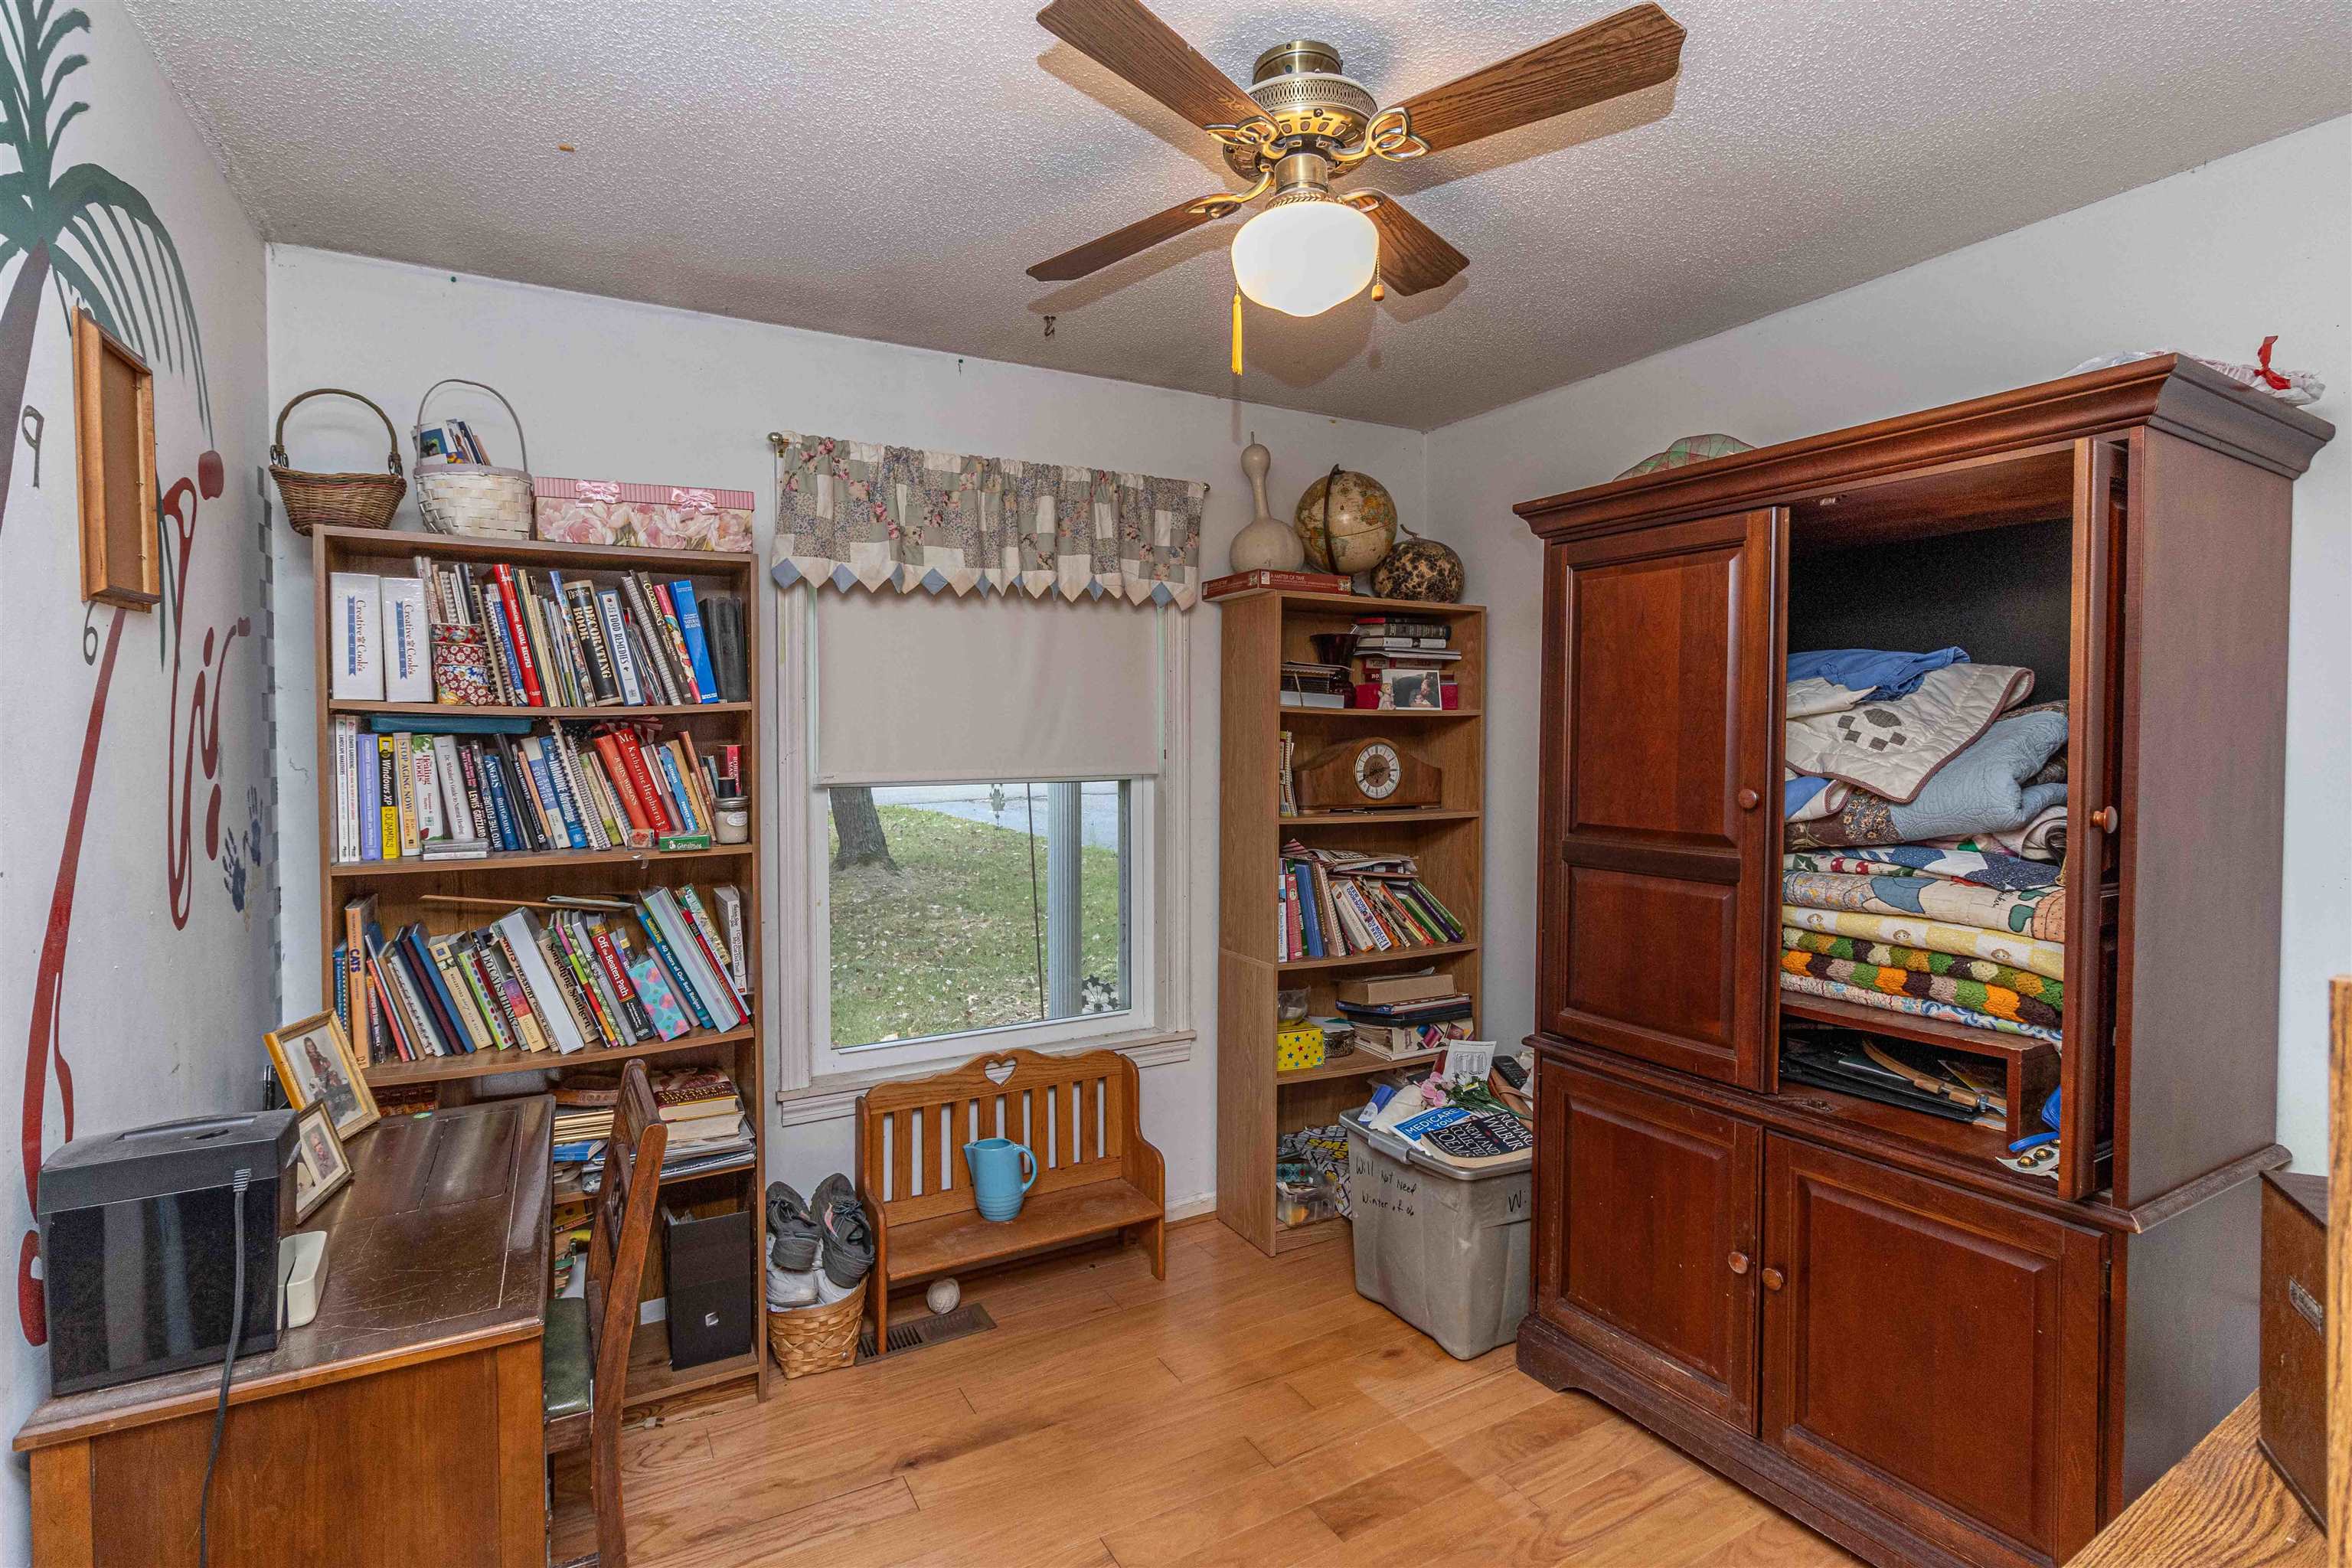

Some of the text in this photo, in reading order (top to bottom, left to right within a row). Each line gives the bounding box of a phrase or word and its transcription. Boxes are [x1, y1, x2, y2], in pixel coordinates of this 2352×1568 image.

[355, 599, 368, 671] Creative Cook's
[403, 605, 418, 675] Creative Cook's
[572, 606, 590, 641] BOOK
[606, 614, 629, 665] FOOD REMEDIES
[516, 624, 532, 668] ANNUAL RECIPES
[583, 605, 612, 679] DECORATING
[506, 651, 521, 688] COOKING
[617, 733, 635, 743] Me
[382, 760, 392, 805] Windows XP
[401, 764, 410, 788] AGING
[416, 758, 424, 782] Foods
[423, 755, 432, 785] Healing
[485, 760, 501, 788] ANGELS
[514, 762, 530, 799] MARIA SHRIVER
[533, 766, 549, 804] SOLUTION
[613, 755, 627, 778] JUSTIN
[622, 779, 638, 805] WILSON'S
[628, 746, 662, 821] Katharine Hepburn
[544, 779, 554, 802] SUGAR
[548, 761, 567, 792] IMMUNE
[558, 793, 576, 823] Advantage
[385, 813, 394, 848] DUMMIES
[469, 790, 485, 838] LEWIS GRIZZARD
[483, 795, 501, 848] INTO THE FUTURE
[1349, 886, 1359, 897] NEW
[1359, 897, 1367, 912] YORK
[1376, 926, 1387, 942] MOLLY
[349, 949, 361, 973] CATS
[597, 936, 609, 949] Off
[605, 956, 621, 979] Beaten
[616, 979, 629, 996] Path
[665, 952, 676, 967] Years
[677, 972, 686, 982] Our
[482, 954, 494, 969] DO
[488, 970, 505, 993] CATS
[498, 994, 520, 1027] THINK?
[515, 964, 535, 1000] TREASURY
[546, 942, 592, 1030] Something Southern
[683, 982, 694, 992] Best
[688, 992, 701, 1011] Recipes
[1405, 1109, 1459, 1134] MEDICARE
[1435, 1118, 1453, 1129] YOU
[1463, 1122, 1501, 1155] NEW AND
[1484, 1117, 1524, 1151] WILBUR
[1306, 1138, 1348, 1152] EWS
[1450, 1125, 1488, 1156] COLLECTED
[1356, 1157, 1374, 1177] Will
[1396, 1179, 1417, 1195] Need
[1362, 1190, 1388, 1207] Winter
